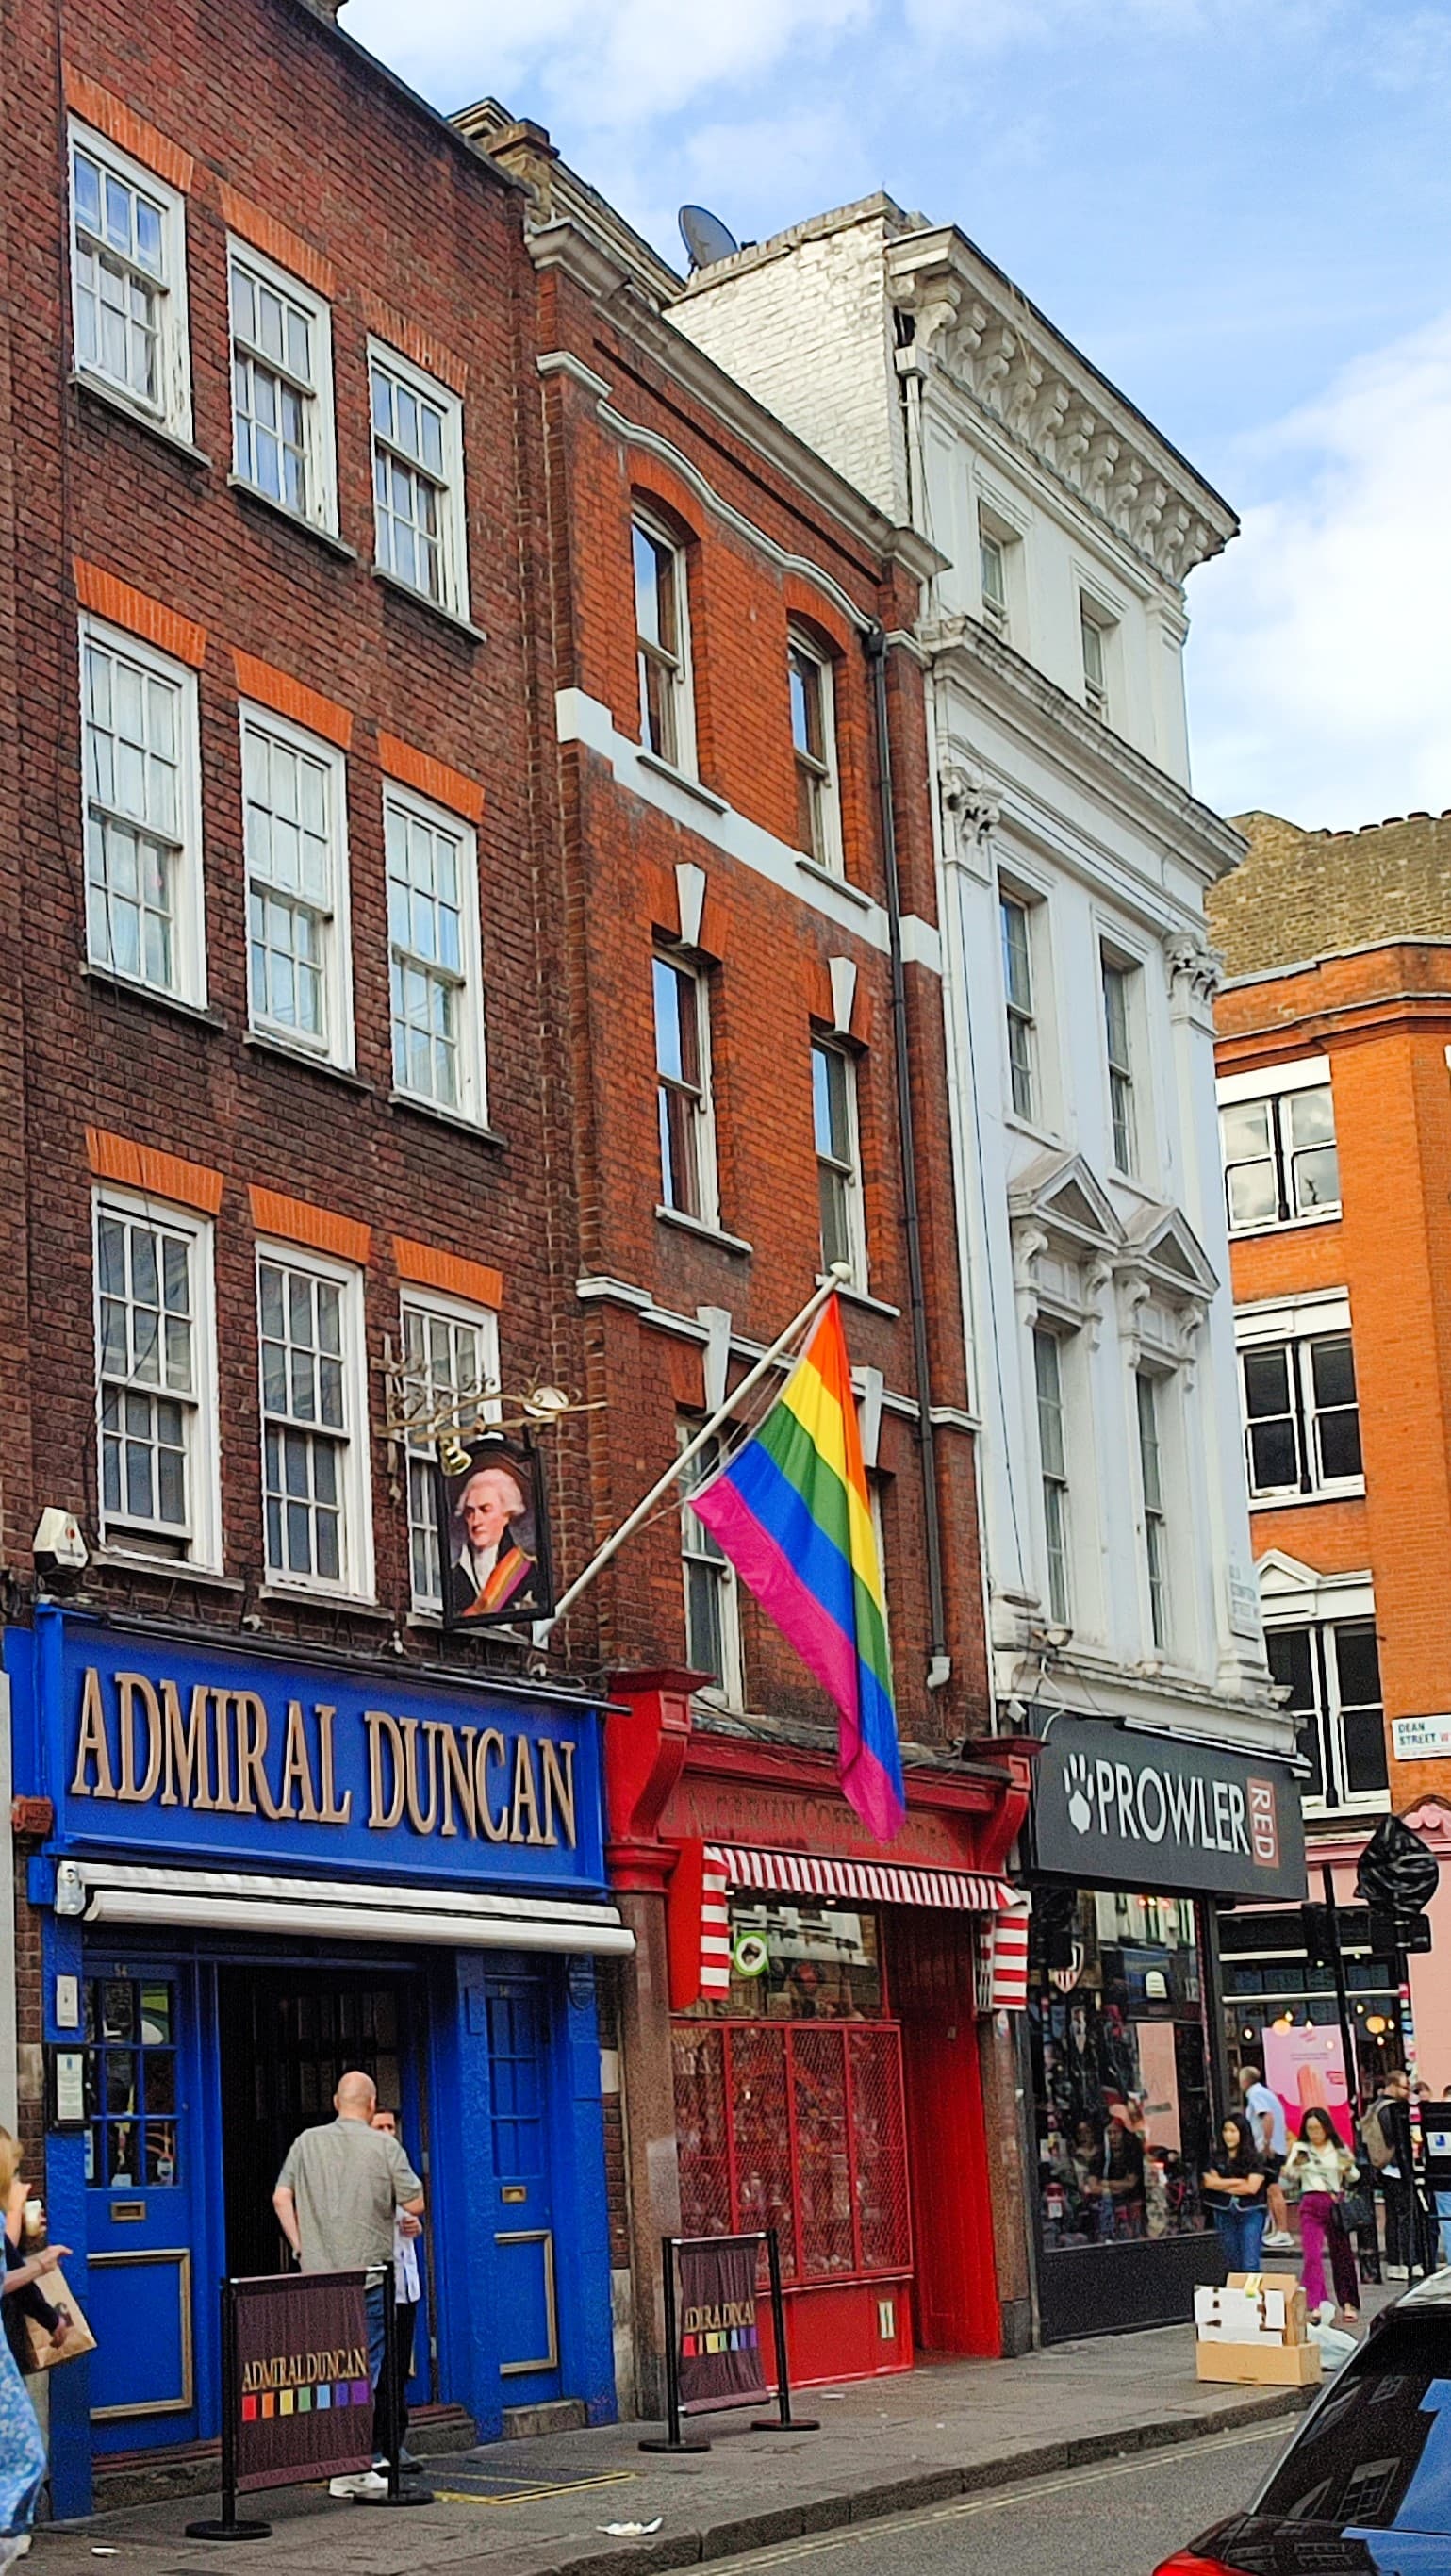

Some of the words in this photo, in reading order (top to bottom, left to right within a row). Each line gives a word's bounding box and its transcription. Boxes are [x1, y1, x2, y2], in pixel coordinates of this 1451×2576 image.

[1398, 1723, 1425, 1733] DEAN
[1400, 1733, 1435, 1745] STREET
[71, 1667, 352, 1824] ADMIRAL
[364, 1710, 576, 1849] DUNCAN
[1096, 1759, 1251, 1856] PROWLER
[1251, 1787, 1275, 1859] RED
[242, 2354, 306, 2392] ADMIRAL
[306, 2347, 367, 2383] DUNCAN
